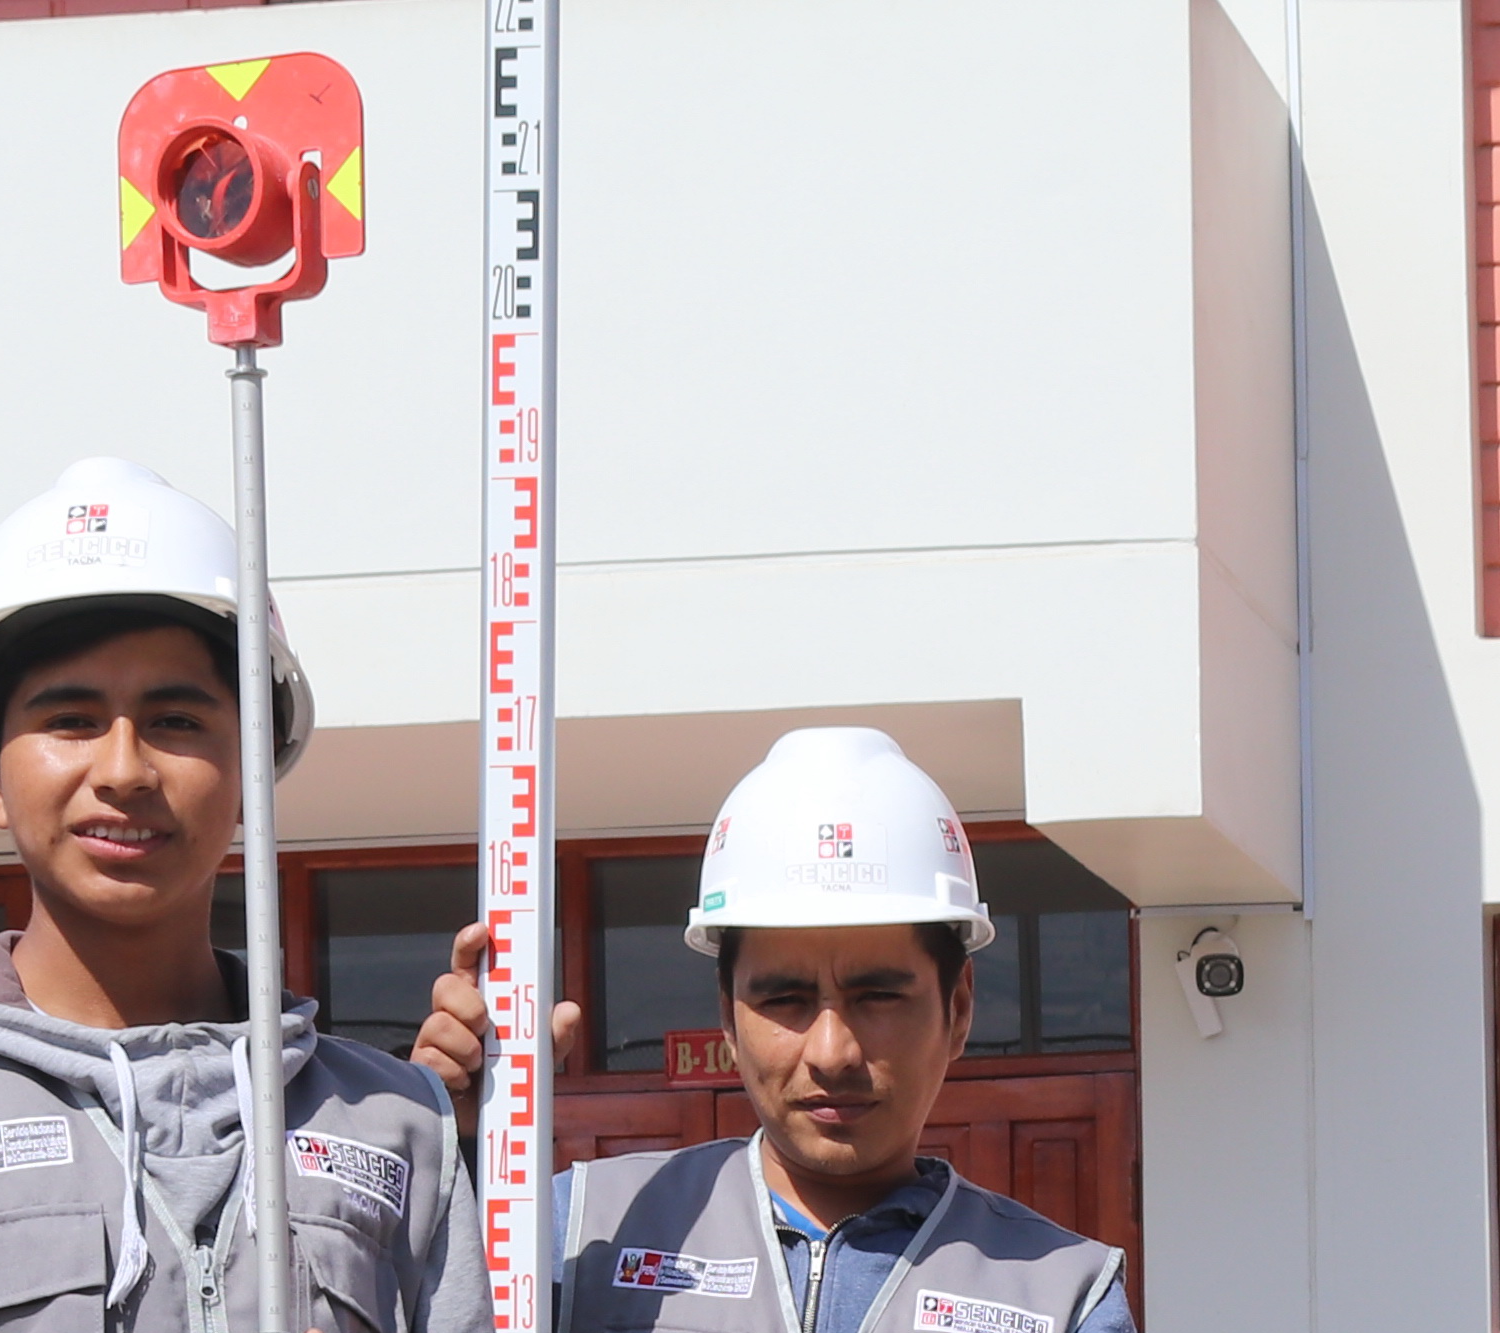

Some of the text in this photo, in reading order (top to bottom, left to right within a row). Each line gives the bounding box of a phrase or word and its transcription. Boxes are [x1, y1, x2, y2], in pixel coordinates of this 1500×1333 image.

[518, 120, 541, 175] 21
[493, 265, 515, 320] 20
[516, 408, 539, 463] 19
[27, 536, 147, 568] SENCICO
[67, 556, 102, 566] TACNA
[491, 552, 513, 607] 18
[514, 696, 537, 751] 17
[489, 840, 511, 895] 16
[786, 862, 888, 885] SENCICO
[512, 984, 535, 1040] 15
[676, 1041, 740, 1075] B-10
[328, 1140, 406, 1190] SENCICO
[487, 1129, 509, 1185] 14
[511, 1274, 533, 1330] 13
